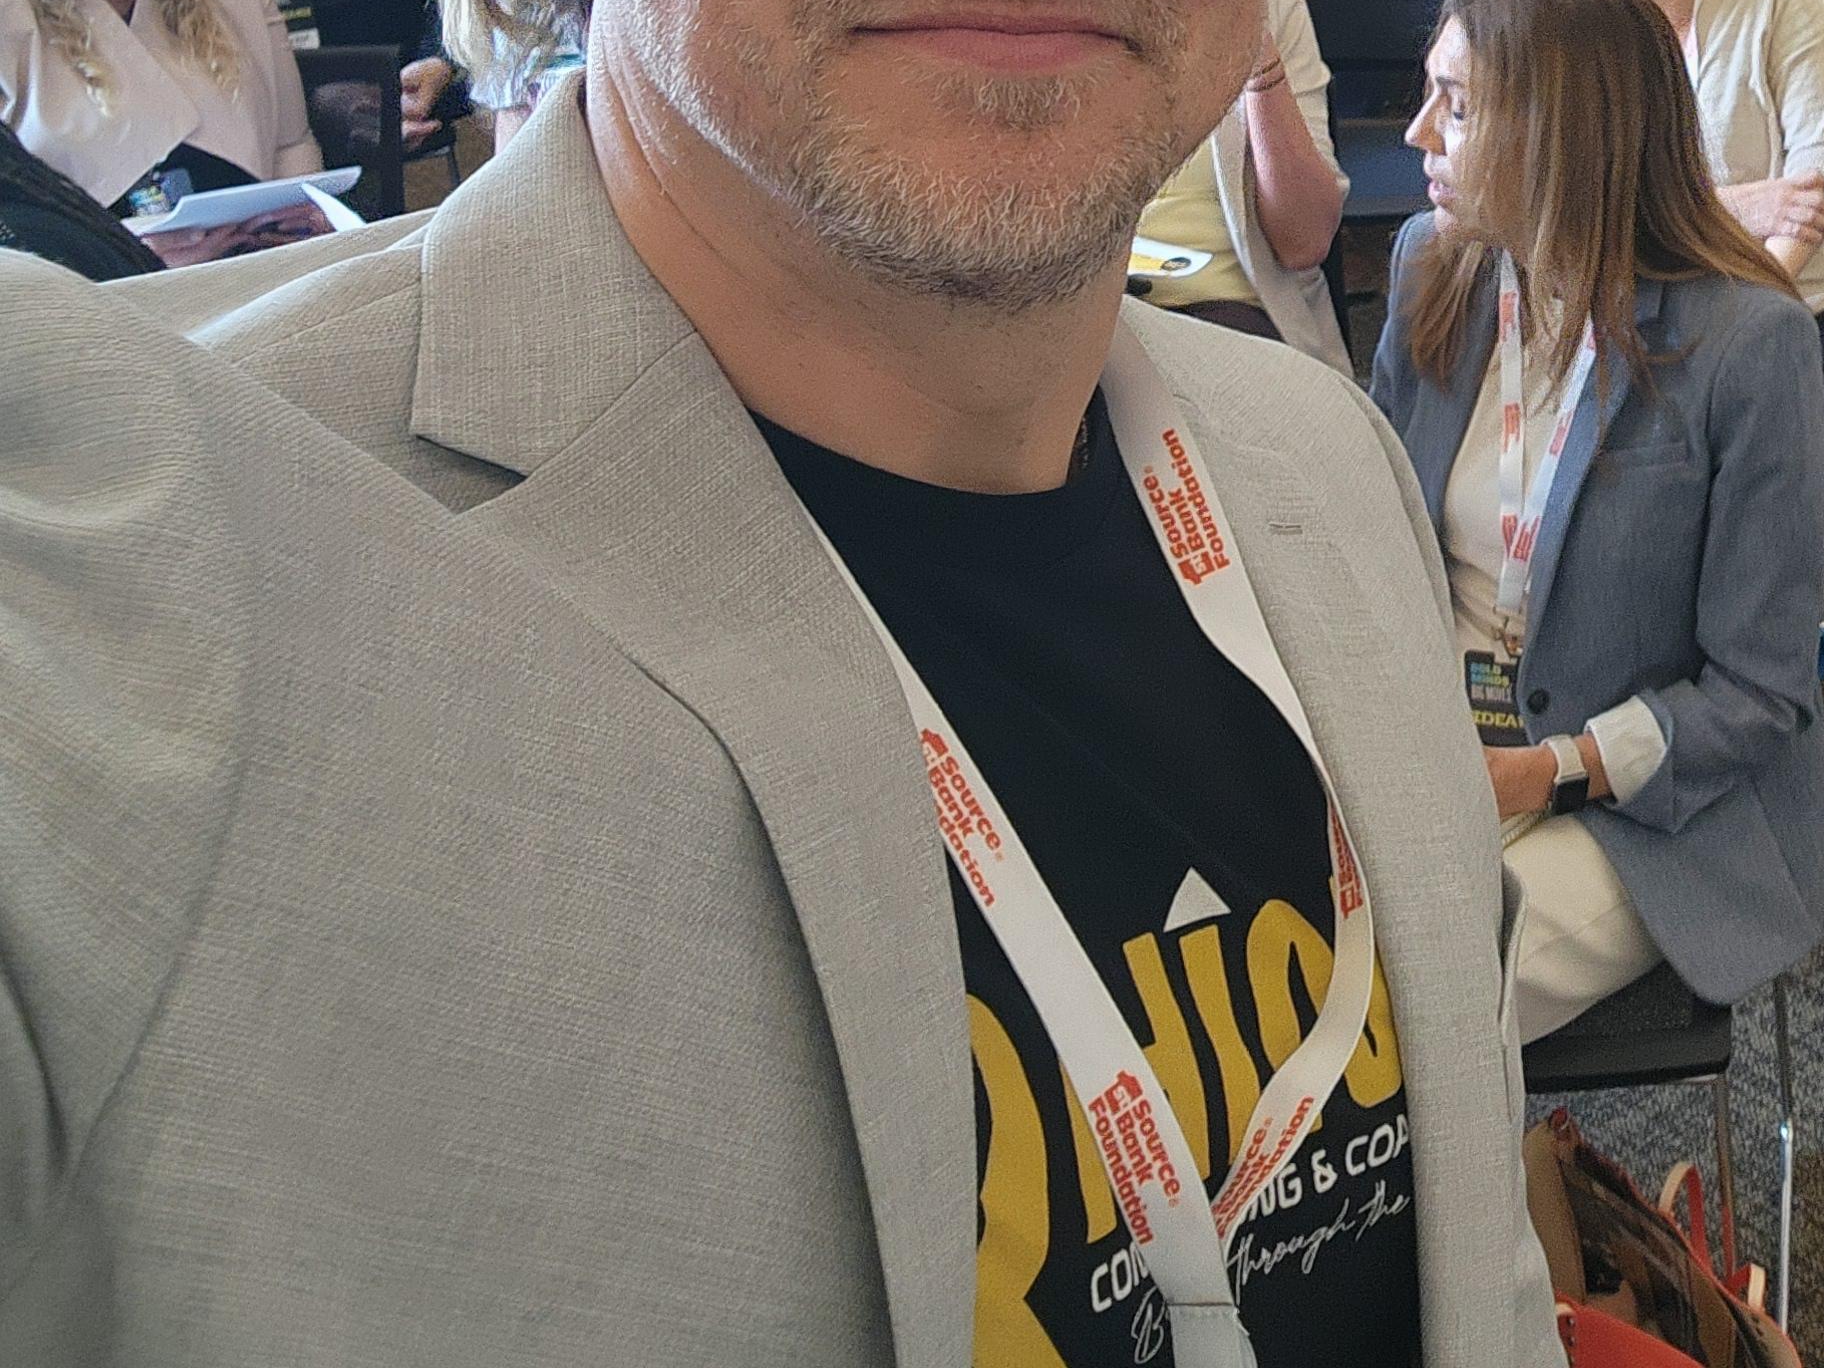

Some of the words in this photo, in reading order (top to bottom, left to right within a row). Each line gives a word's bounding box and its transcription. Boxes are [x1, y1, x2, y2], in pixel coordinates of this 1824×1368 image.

[1143, 474, 1189, 559] Source
[1162, 428, 1231, 570] Foundation
[1168, 487, 1206, 553] Bank
[928, 766, 974, 839] Bank
[940, 755, 1001, 851] Source
[1088, 1093, 1154, 1245] Foundation
[1116, 1109, 1154, 1186] Bank
[1132, 1098, 1181, 1198] Source
[1311, 1149, 1338, 1194] &
